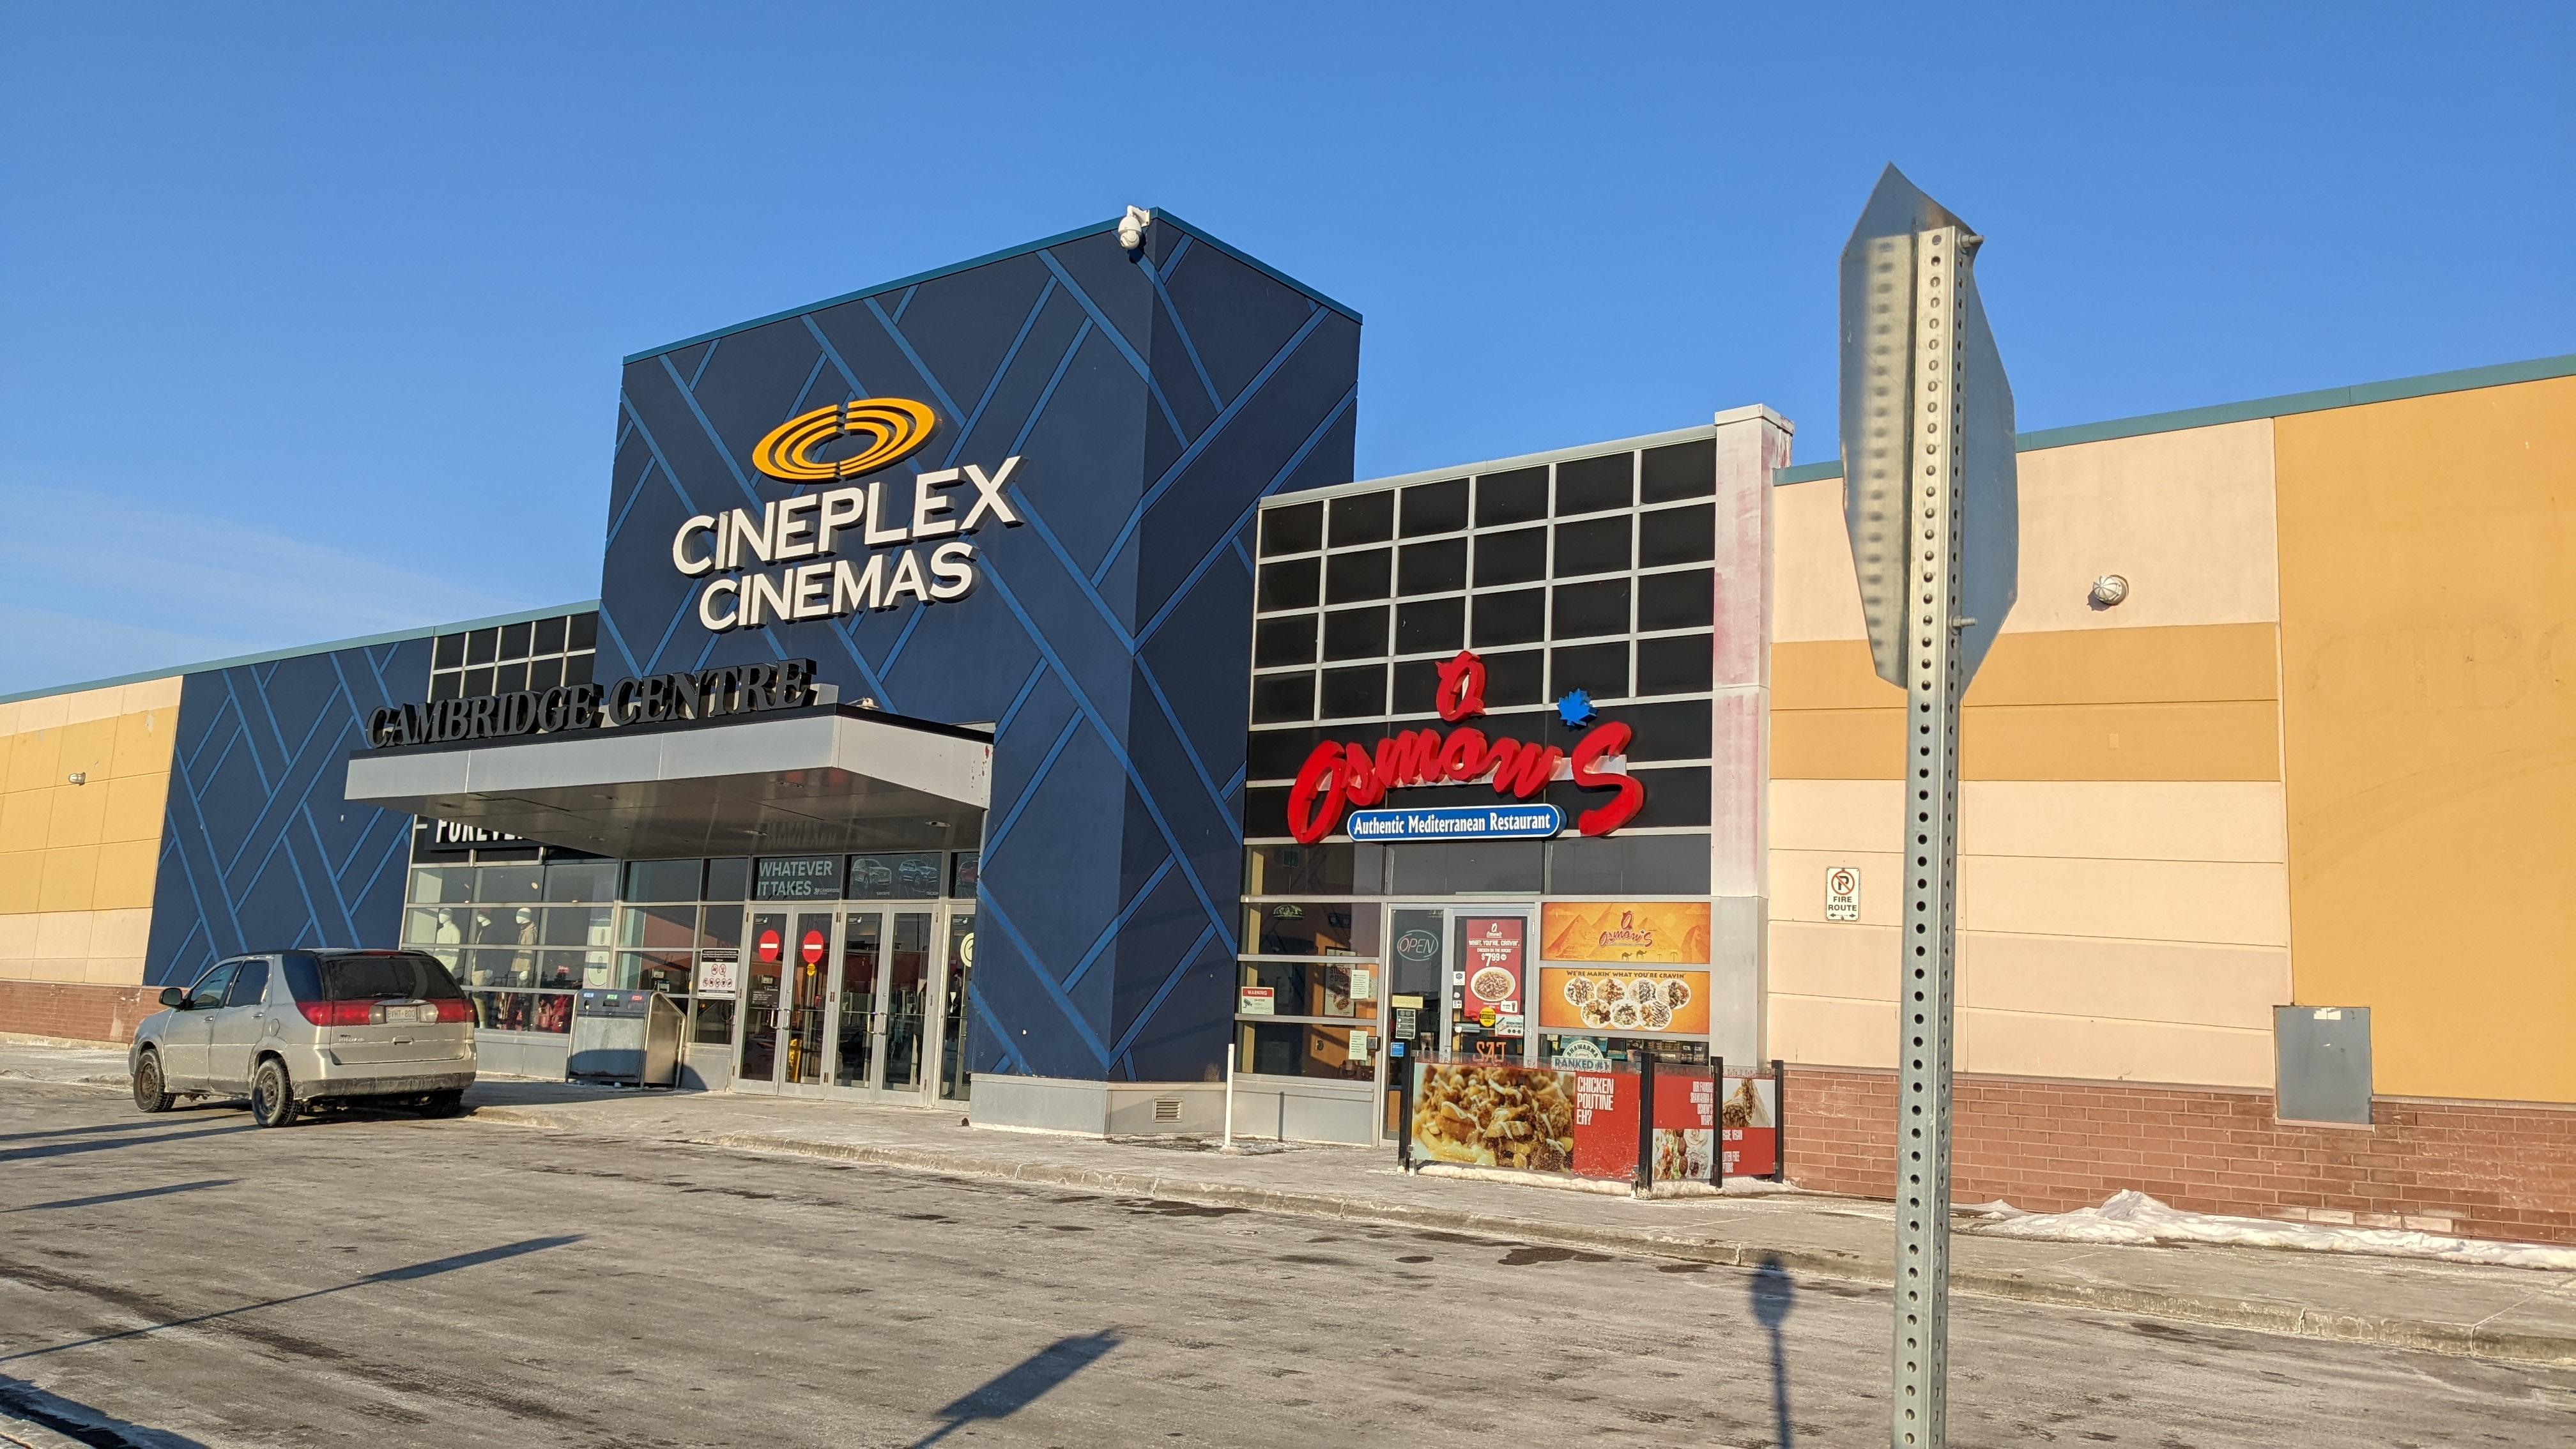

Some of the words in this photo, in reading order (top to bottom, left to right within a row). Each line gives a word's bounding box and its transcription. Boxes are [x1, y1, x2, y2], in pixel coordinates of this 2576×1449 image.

[673, 456, 1024, 578] CINEPLEX
[700, 542, 977, 631] CINEMAS
[367, 683, 602, 748] CAMBRIDGE
[609, 657, 816, 726] CENTRE
[1353, 816, 1405, 835] Authentic
[1407, 814, 1485, 833] Mediterranean
[1489, 813, 1551, 832] Restaurant
[759, 861, 833, 877] WHATEVER
[757, 882, 769, 896] IT
[771, 880, 812, 896] TAKES
[1399, 938, 1435, 953] OPEN
[1567, 1044, 1598, 1058] SHAWARMA
[1554, 1058, 1594, 1070] RANKED
[1577, 1077, 1614, 1094] CHICKEN
[1577, 1093, 1614, 1110] POUTINE
[1576, 1108, 1592, 1125] EH?
[1701, 1115, 1713, 1126] WRAPS
